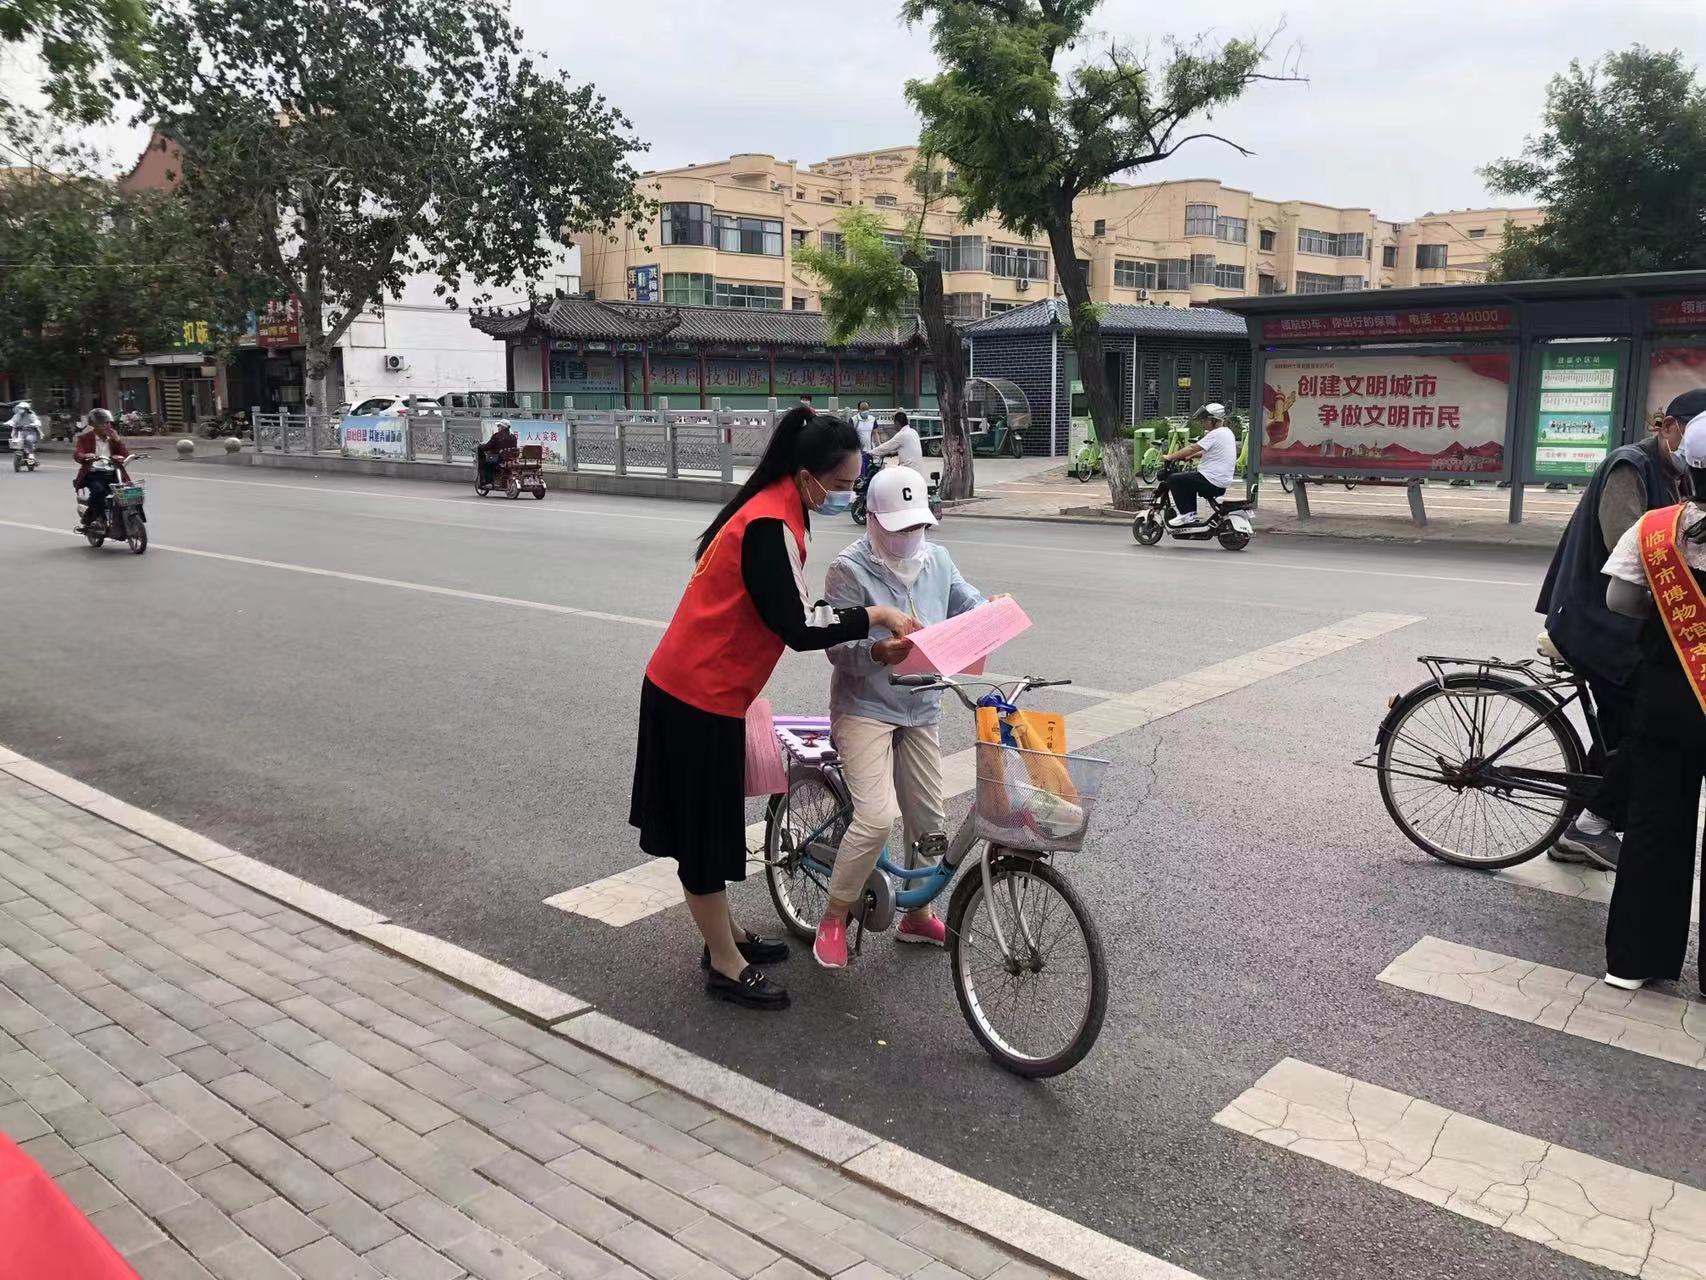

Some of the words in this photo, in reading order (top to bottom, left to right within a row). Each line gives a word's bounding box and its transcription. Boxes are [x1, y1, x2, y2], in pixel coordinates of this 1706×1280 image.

[1297, 374, 1438, 398] 创建文明城市
[1318, 404, 1462, 429] 争做文明市民
[902, 487, 912, 501] C
